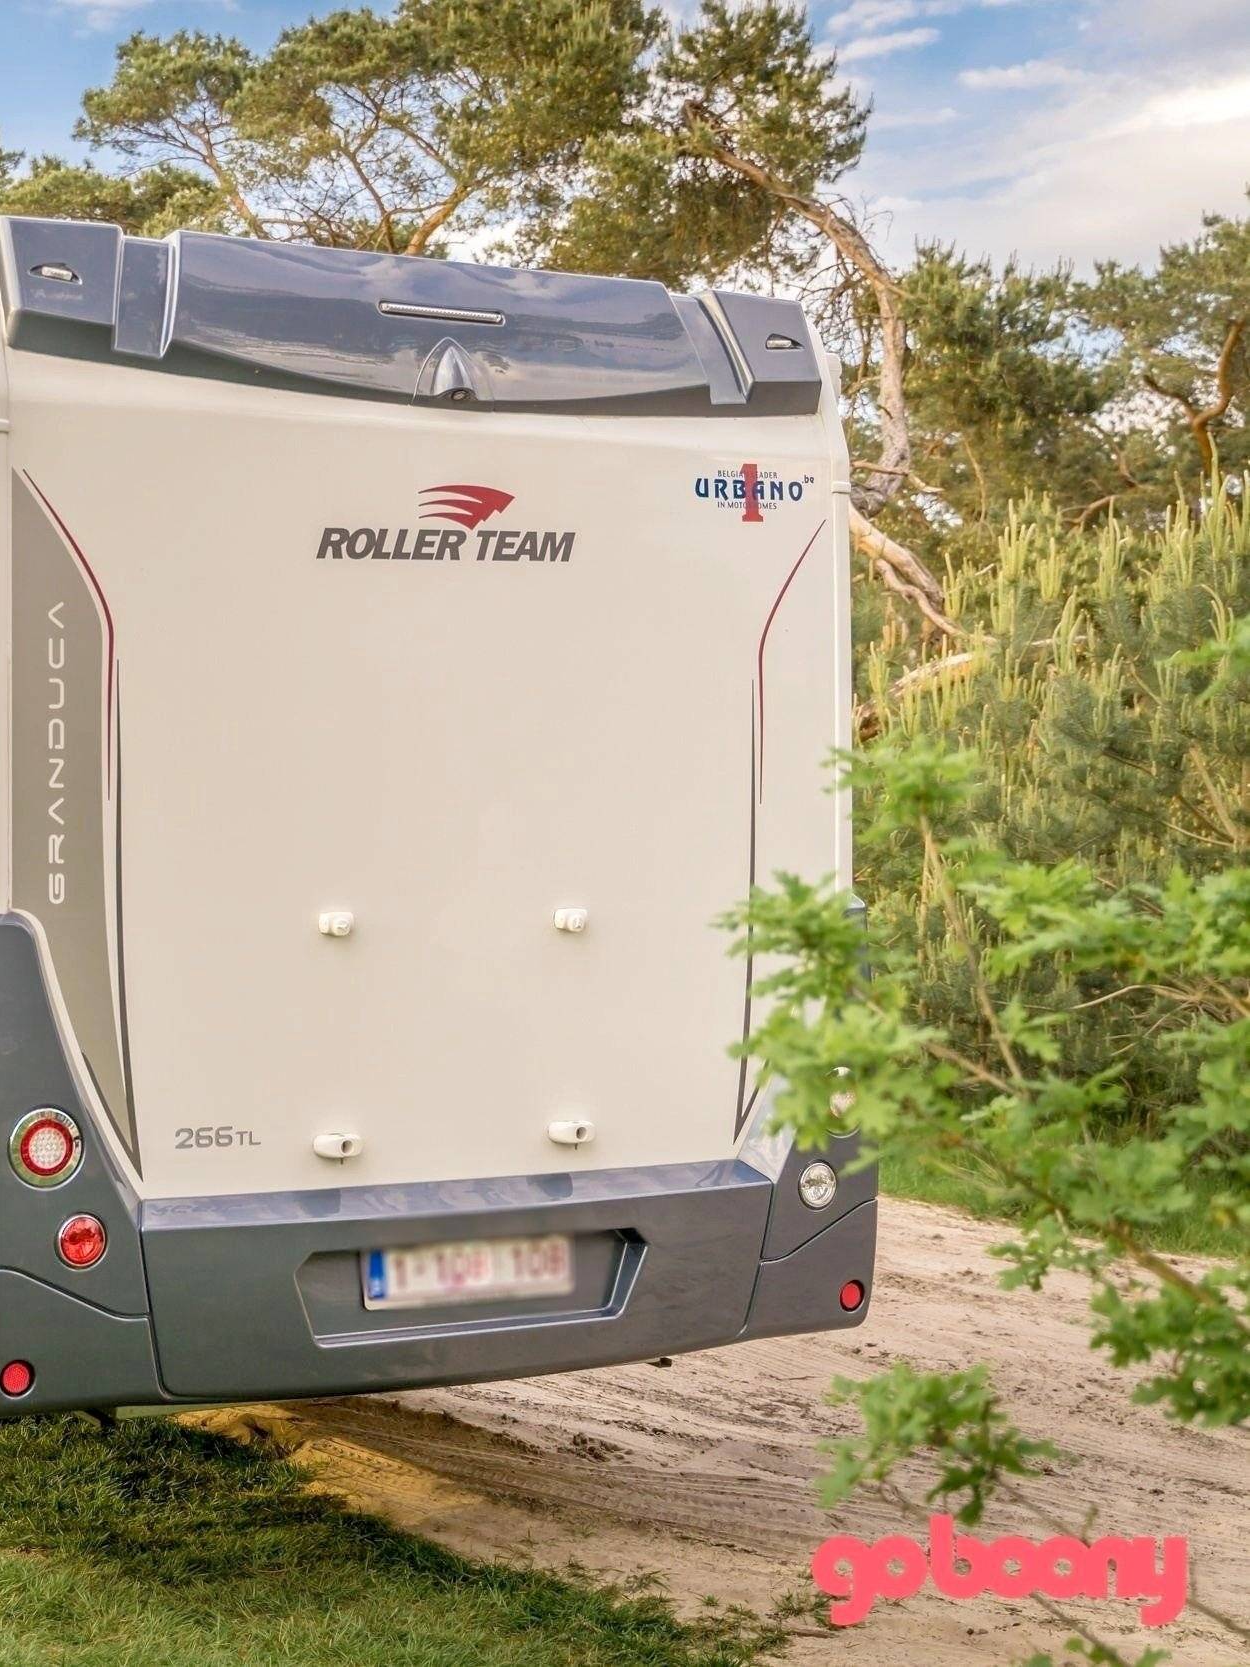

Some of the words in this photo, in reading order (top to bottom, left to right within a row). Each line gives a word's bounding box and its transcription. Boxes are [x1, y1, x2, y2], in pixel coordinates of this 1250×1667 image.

[316, 527, 467, 561] ROLLER
[476, 530, 576, 562] TEAM
[48, 601, 65, 904] GRANDUCA
[174, 1126, 262, 1149] 266TL
